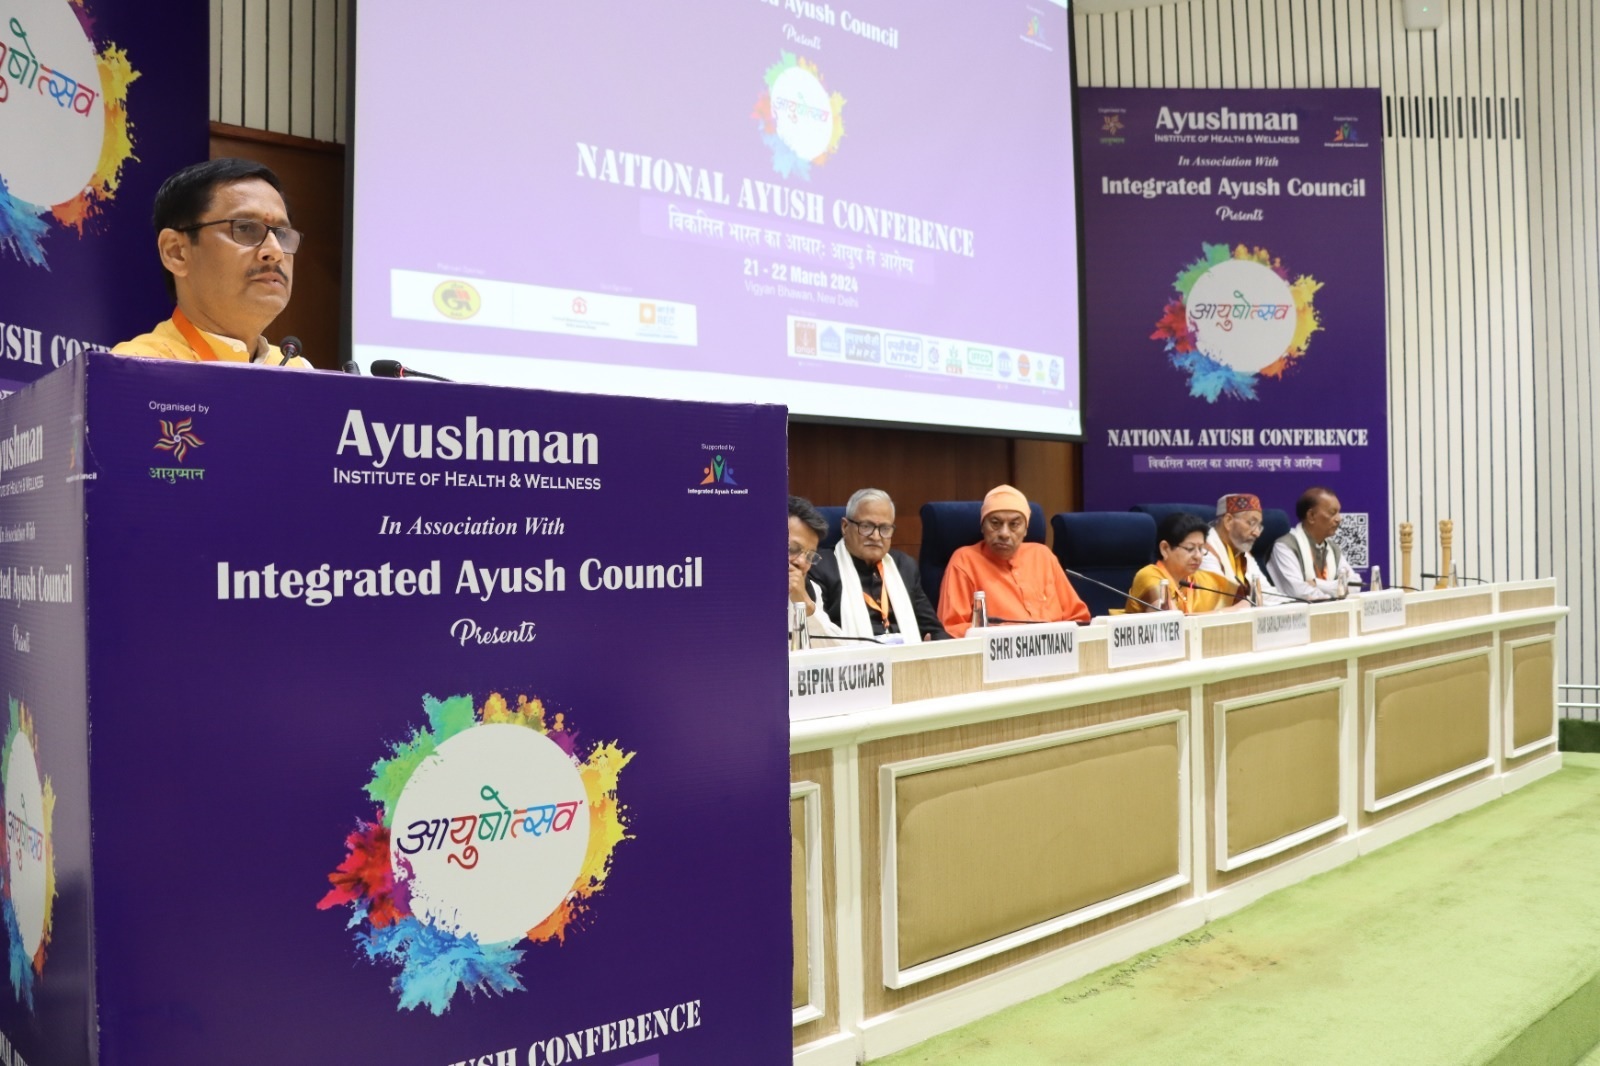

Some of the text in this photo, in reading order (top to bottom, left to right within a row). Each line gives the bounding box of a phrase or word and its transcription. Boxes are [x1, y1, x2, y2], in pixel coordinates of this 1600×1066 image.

[840, 10, 899, 49] Council
[1155, 106, 1298, 134] Ayushman
[1154, 134, 1197, 143] INSTITUTE
[1198, 135, 1210, 143] OF
[1210, 134, 1245, 144] HEALTH
[1254, 134, 1300, 145] WELLNESS
[1178, 155, 1279, 167] In Association With
[576, 142, 975, 258] NATIONAL AYUSH CONFERENCE
[1101, 176, 1366, 199] Integrated Ayush Council
[668, 203, 724, 239] विकसित
[728, 221, 761, 247] भारत
[765, 228, 781, 248] का
[1215, 205, 1264, 221] Presents
[743, 257, 758, 277] 21
[771, 261, 787, 281] 22
[790, 265, 828, 288] March
[830, 272, 859, 293] 2024
[148, 401, 209, 414] Organised by
[336, 409, 599, 468] Ayushman
[1107, 428, 1368, 446] NATIONAL AYUSH CONFERENCE
[149, 467, 205, 484] आयुष्मान
[333, 467, 602, 490] INSTITUTE OF HEALTH & WELLNESS
[378, 515, 565, 535] In Association With
[38, 564, 73, 603] Council
[217, 556, 703, 607] Integrated Ayush Council
[450, 617, 537, 647] Presents
[989, 631, 1073, 661] SHRI SHANTMANU
[1114, 621, 1180, 648] SHRI RAVI IYER
[797, 661, 885, 697] BIPIN KUMAR
[397, 785, 583, 870] आयुषोत्सव
[528, 1000, 701, 1066] CONFERENCE
